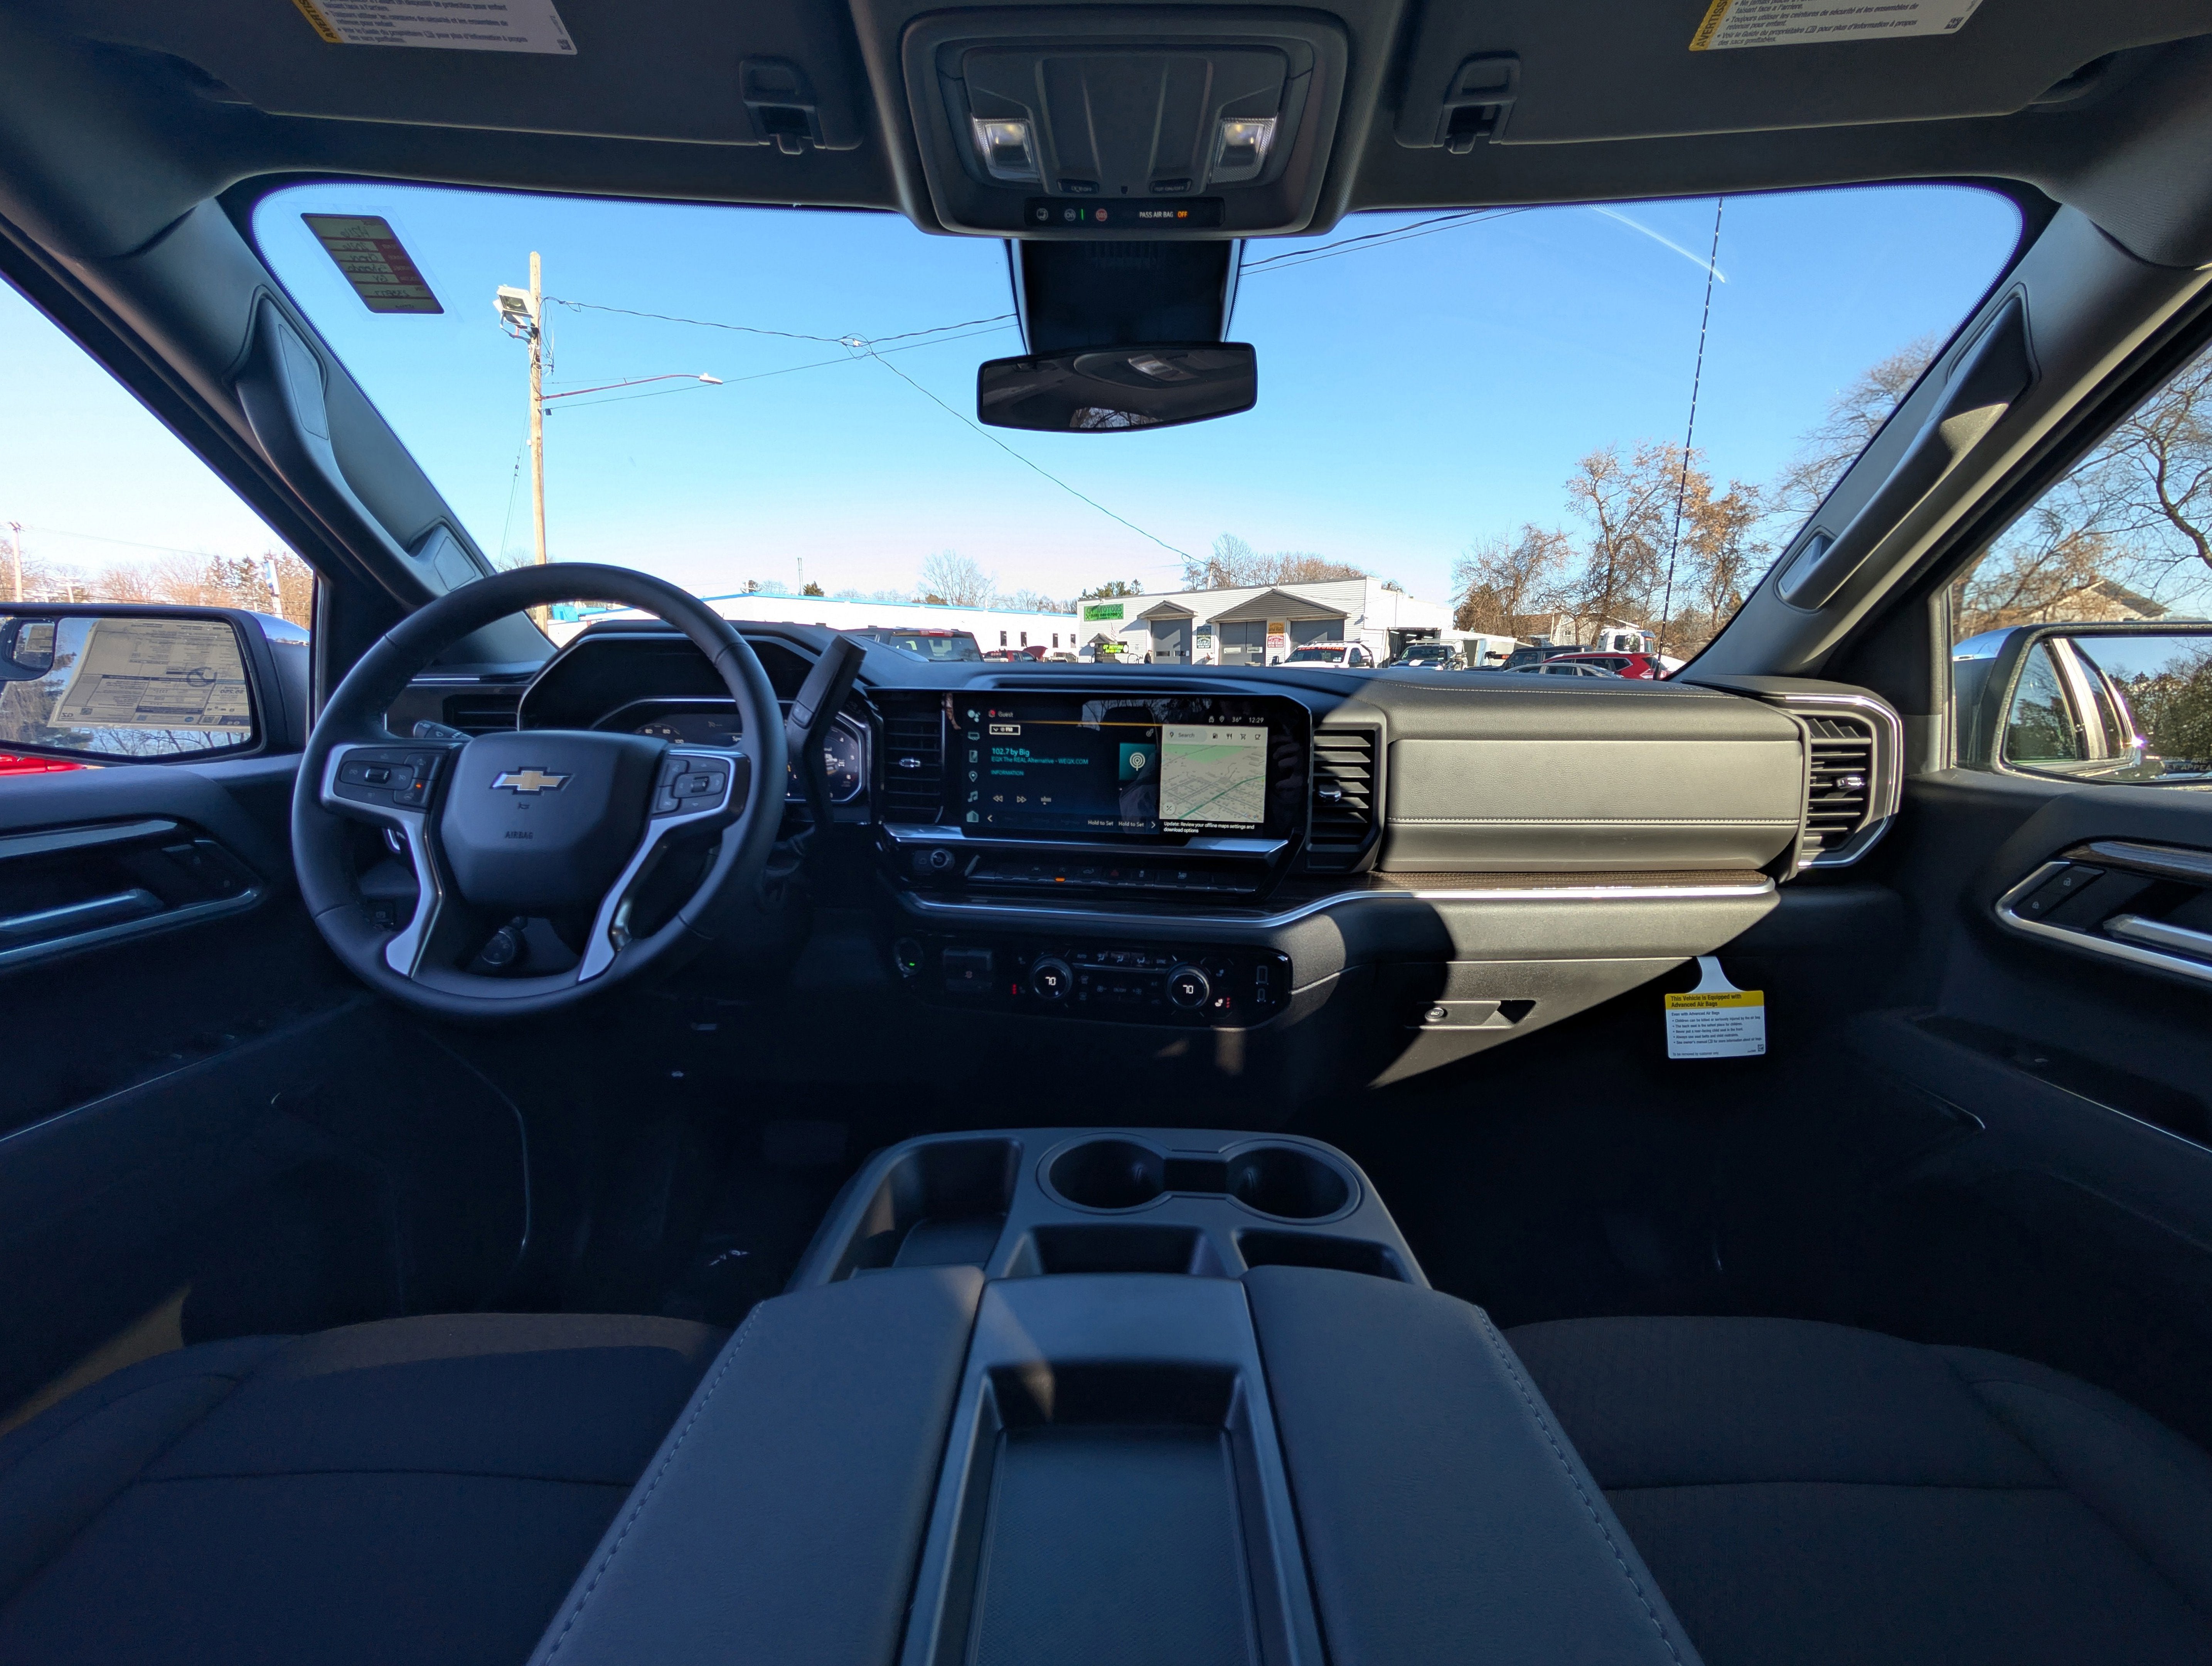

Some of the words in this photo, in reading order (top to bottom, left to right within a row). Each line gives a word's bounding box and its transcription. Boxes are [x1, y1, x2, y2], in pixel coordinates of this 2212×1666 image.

[1010, 748, 1018, 757] by
[1019, 749, 1030, 757] Big
[504, 831, 533, 840] AIRBAG
[1045, 976, 1056, 985] 70
[1183, 985, 1194, 994] 70
